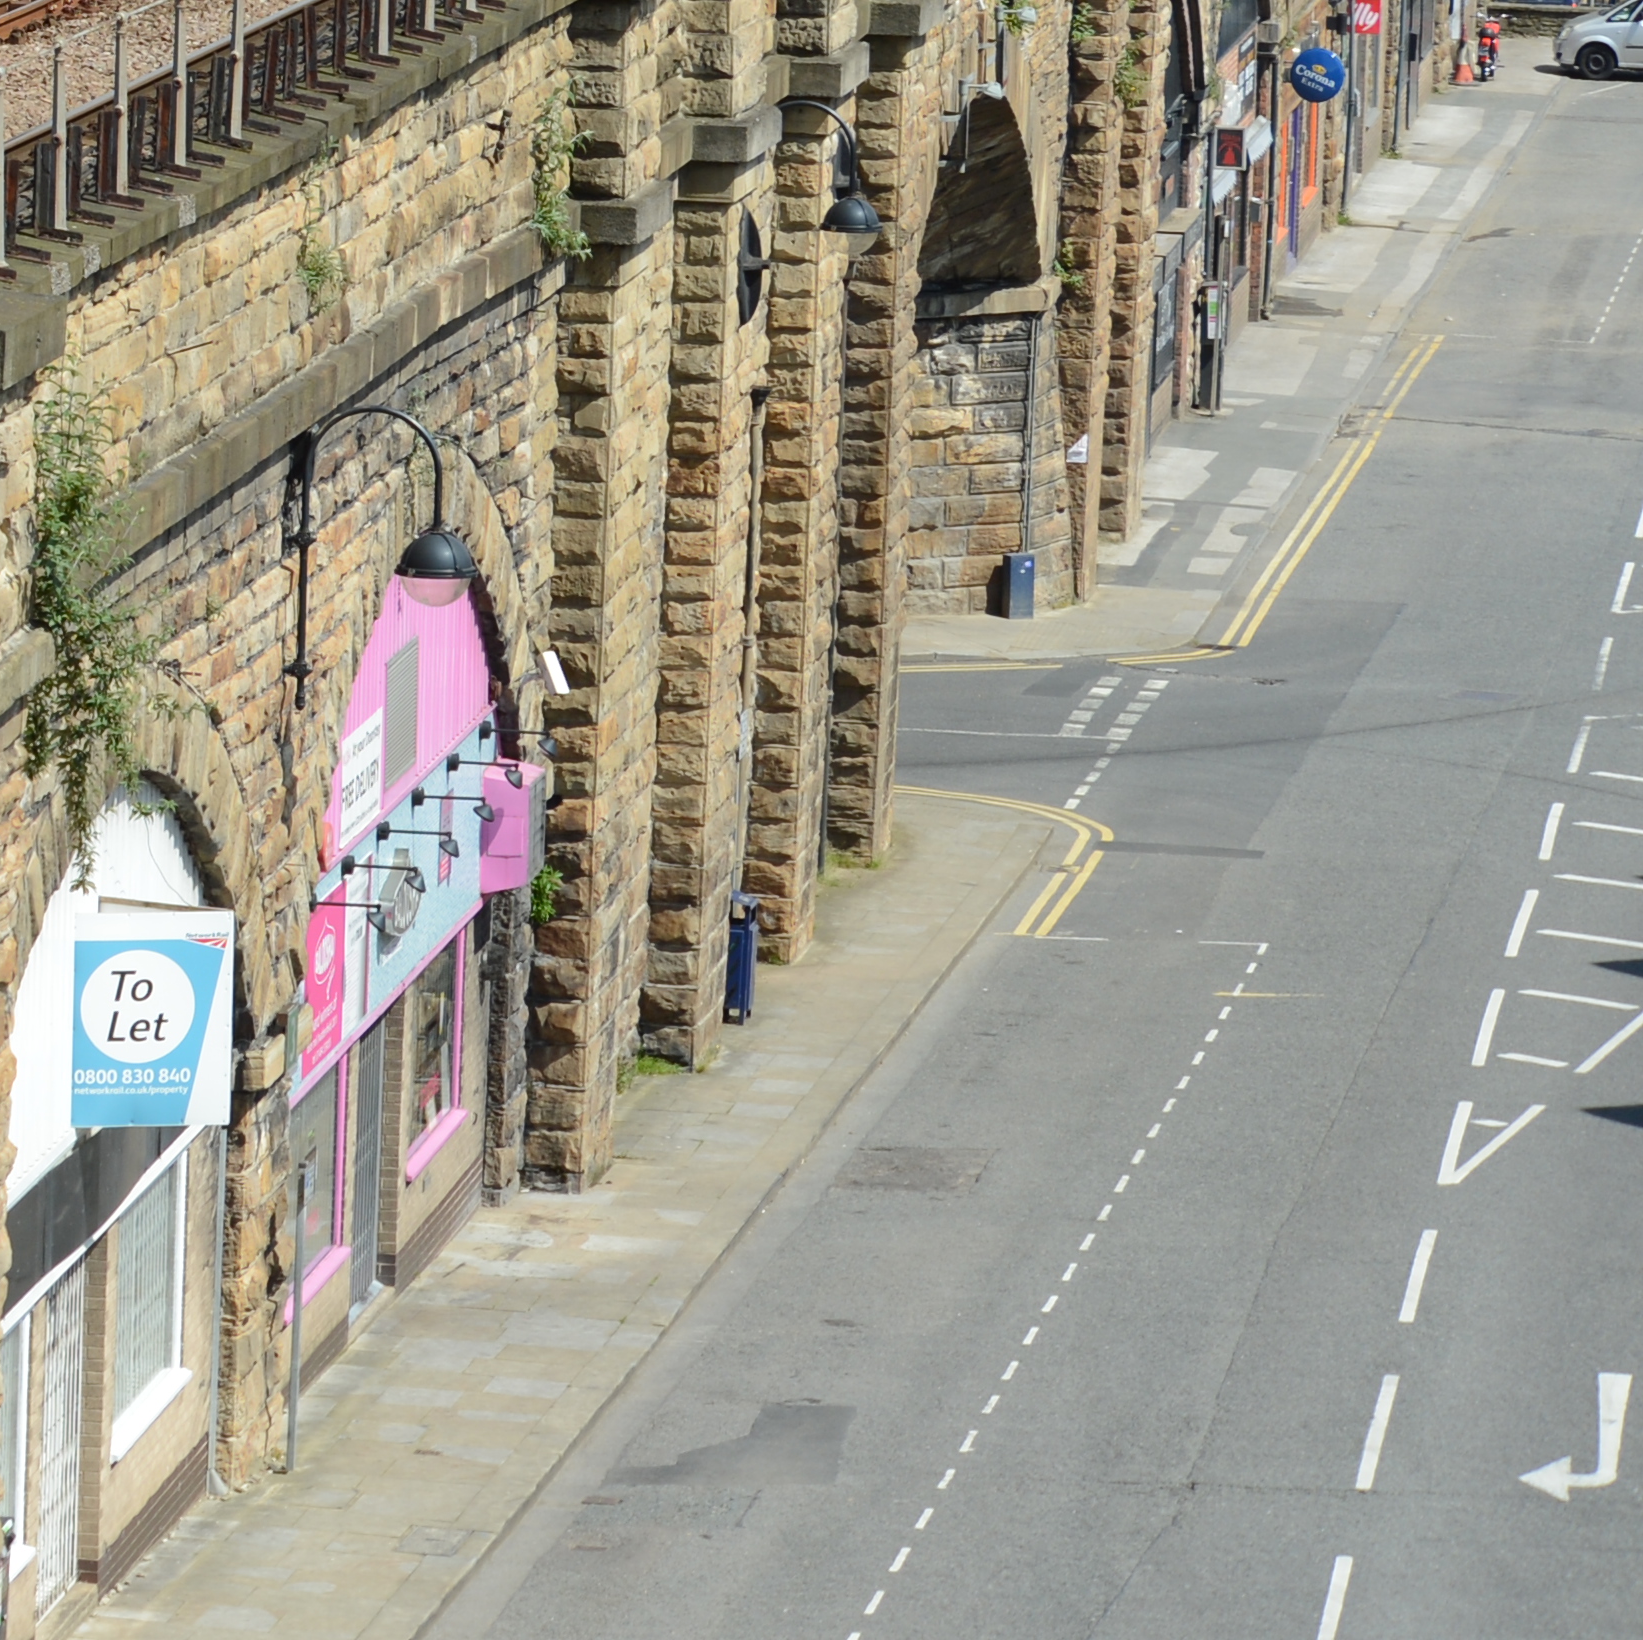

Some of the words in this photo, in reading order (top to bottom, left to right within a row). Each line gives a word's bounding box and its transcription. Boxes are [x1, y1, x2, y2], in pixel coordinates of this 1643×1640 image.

[1349, 1, 1380, 32] lly
[1295, 64, 1336, 88] Corona
[110, 970, 154, 1003] To
[106, 1010, 169, 1043] Let
[73, 1068, 118, 1085] 0800
[121, 1067, 154, 1085] 830
[158, 1067, 191, 1084] 840
[73, 1085, 189, 1096] networkrail.co.uk/property
